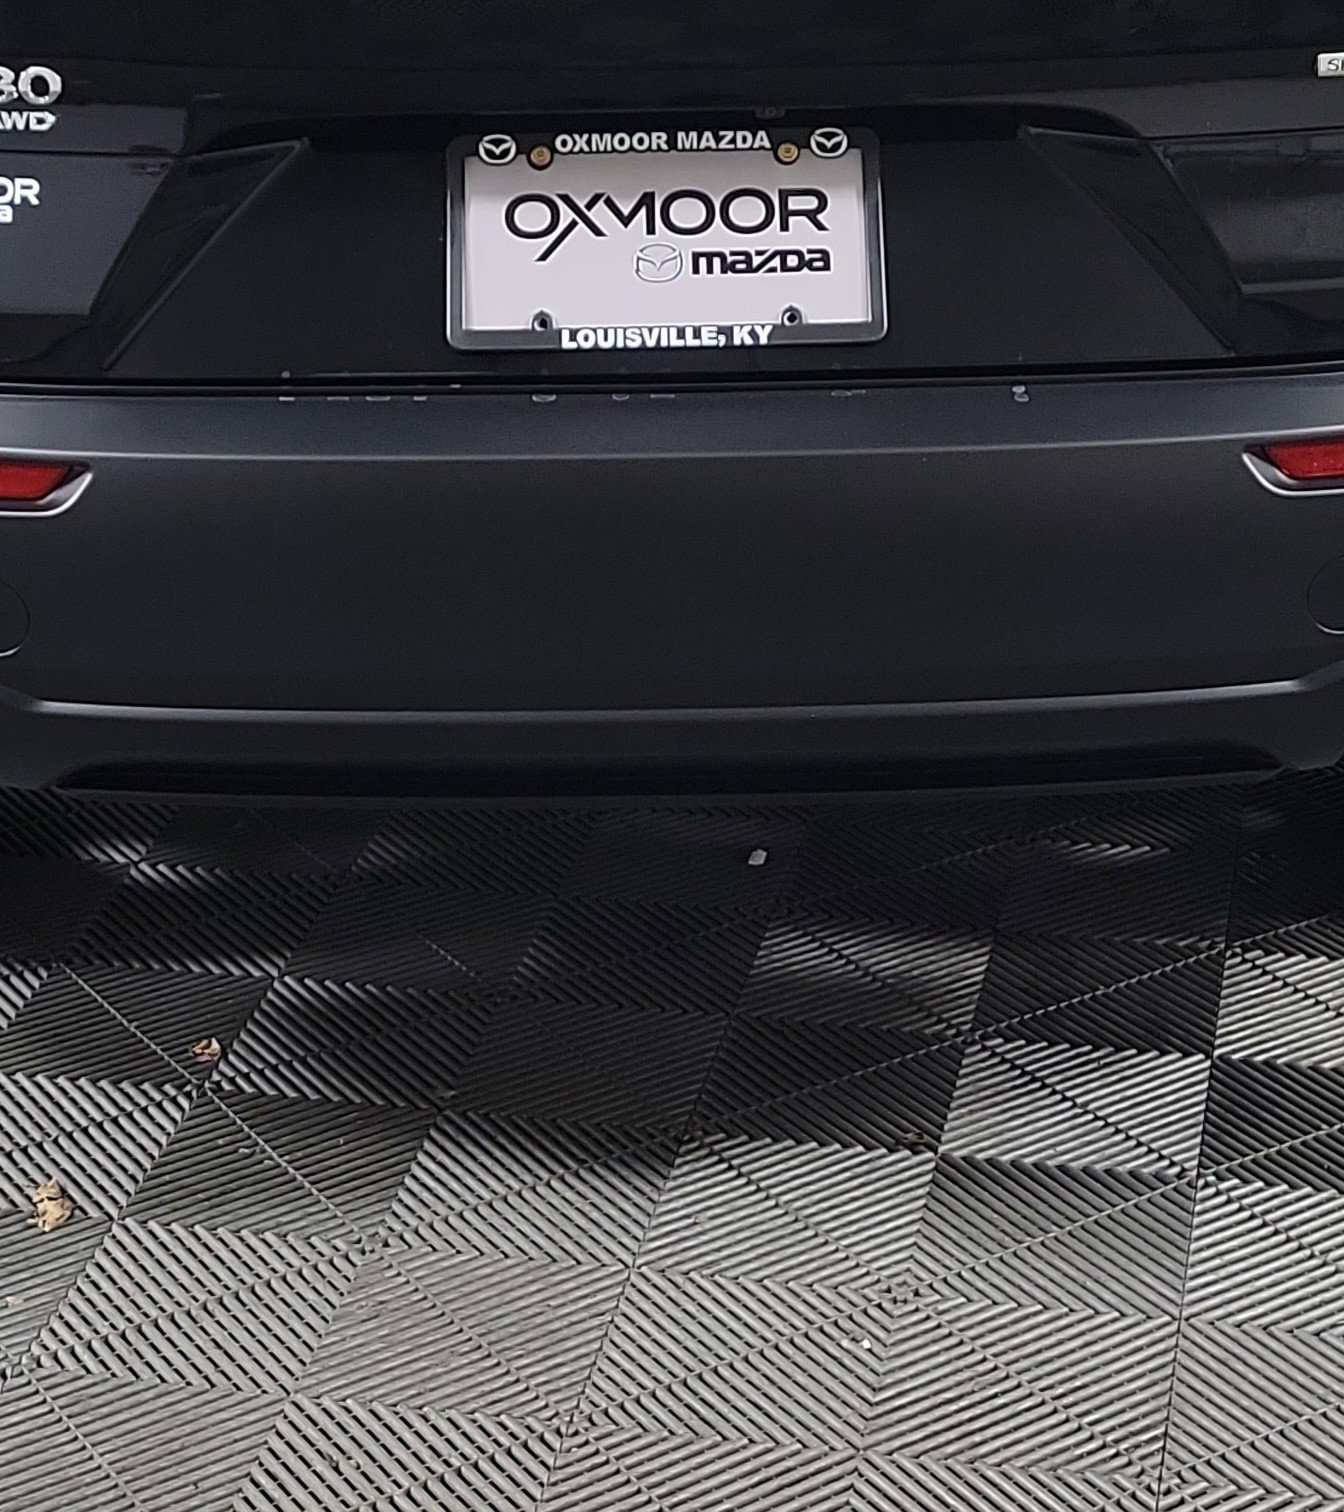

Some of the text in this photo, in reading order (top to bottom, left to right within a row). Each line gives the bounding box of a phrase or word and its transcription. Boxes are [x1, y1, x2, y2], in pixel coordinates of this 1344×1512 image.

[554, 130, 772, 155] OXMOOR MAZDA
[504, 187, 831, 262] OXMOOR
[561, 325, 773, 349] LOUISVILLE, KY
